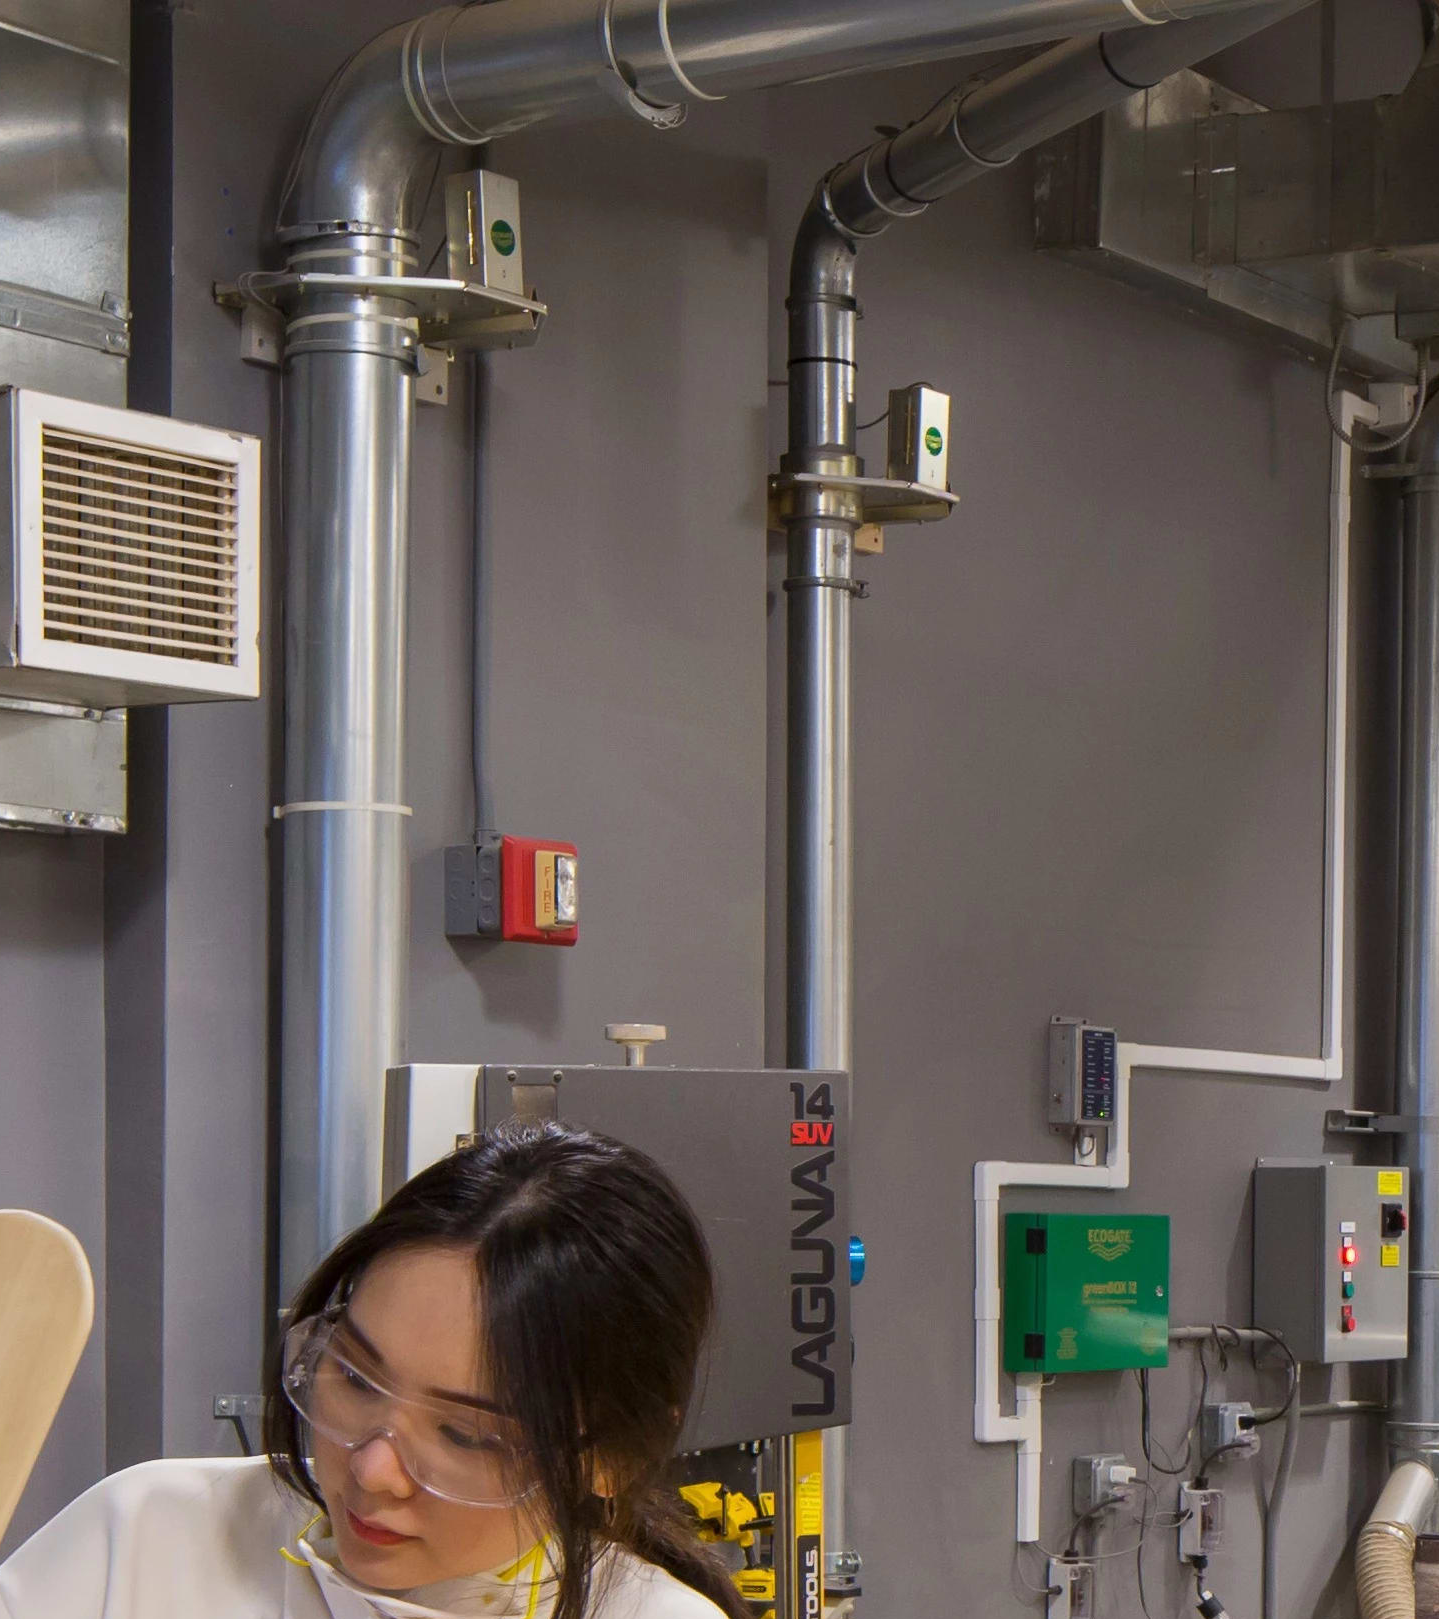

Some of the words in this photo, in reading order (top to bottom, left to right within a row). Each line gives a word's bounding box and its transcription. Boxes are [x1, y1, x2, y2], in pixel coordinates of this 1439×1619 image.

[544, 866, 552, 913] FIRE
[790, 1082, 834, 1119] 14
[792, 1122, 833, 1145] SUV
[1088, 1229, 1133, 1243] ECOGATE
[790, 1151, 836, 1417] LAGUNA
